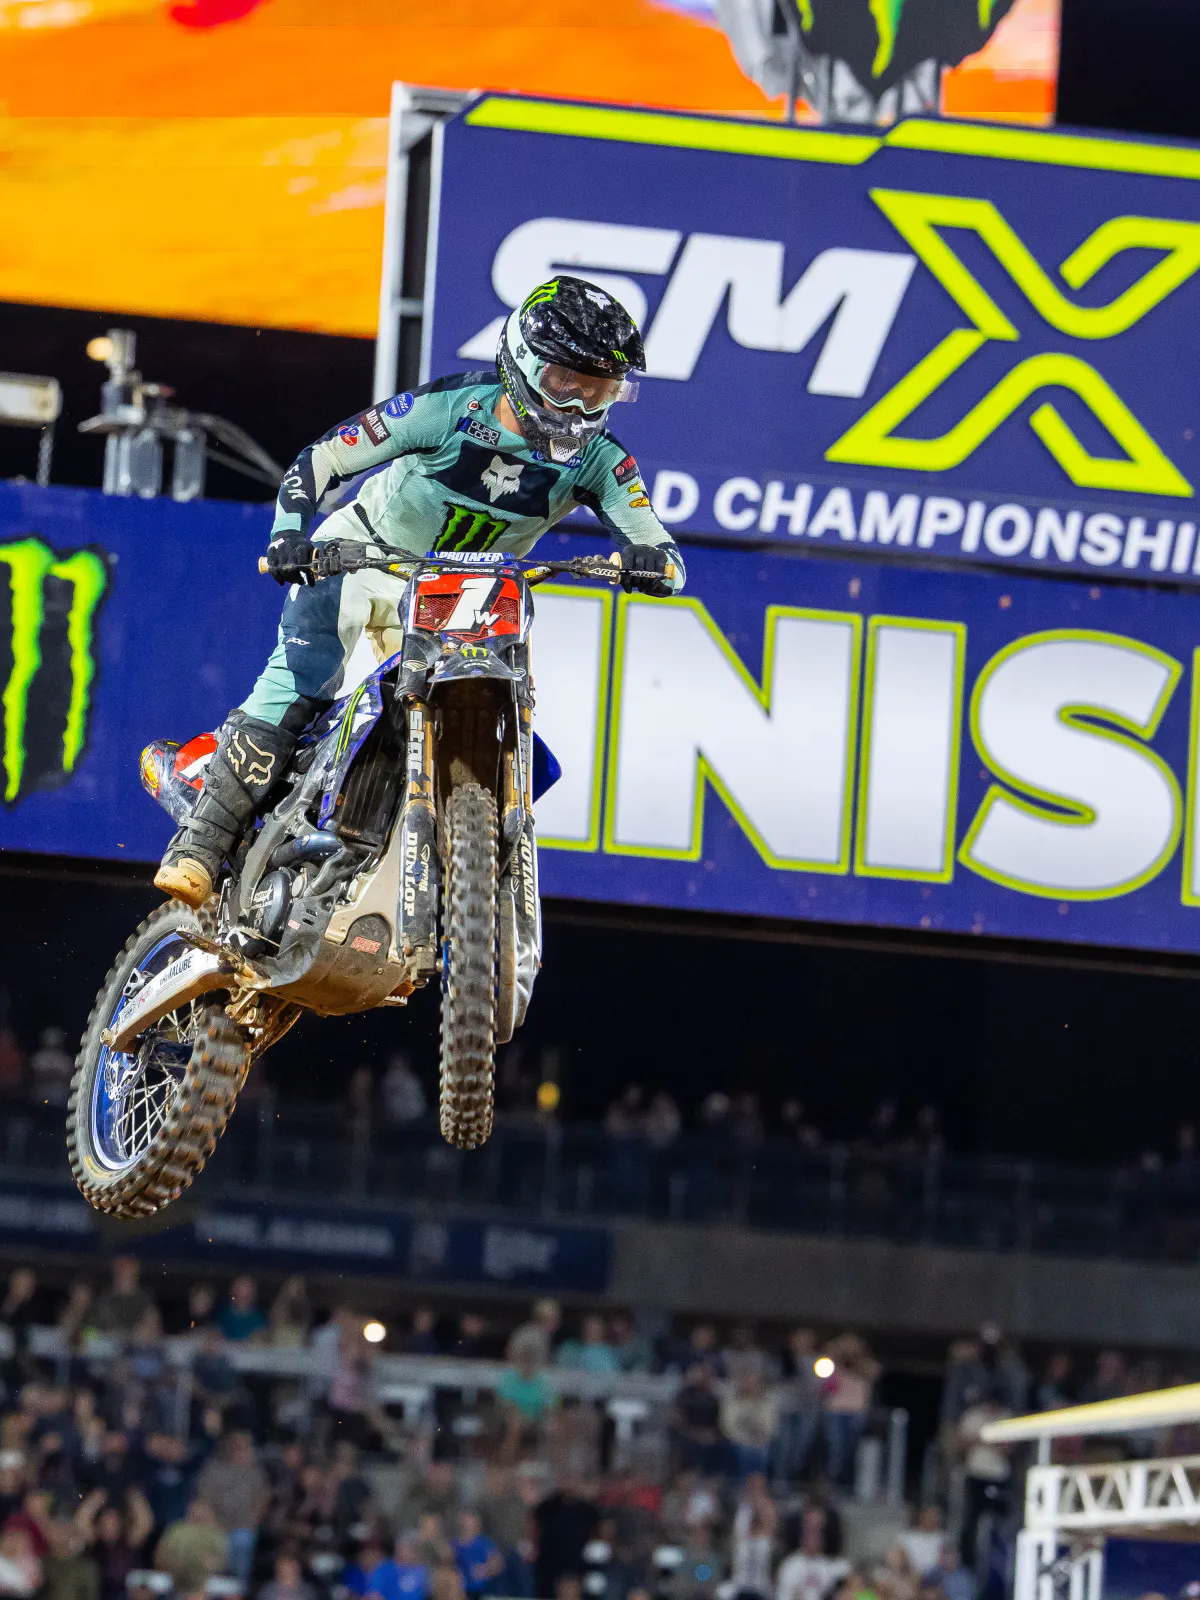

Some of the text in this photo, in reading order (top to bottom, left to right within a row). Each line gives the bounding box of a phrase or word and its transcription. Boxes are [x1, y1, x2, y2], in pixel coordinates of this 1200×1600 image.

[455, 187, 1200, 498] SMX
[467, 428, 497, 445] LOCK
[470, 420, 499, 438] QUAD
[713, 476, 1200, 576] CHAMPIONSHI
[441, 577, 497, 630] 1
[534, 583, 1200, 906] INIS
[404, 831, 418, 917] DUNLOP
[521, 832, 535, 920] DUNLOP
